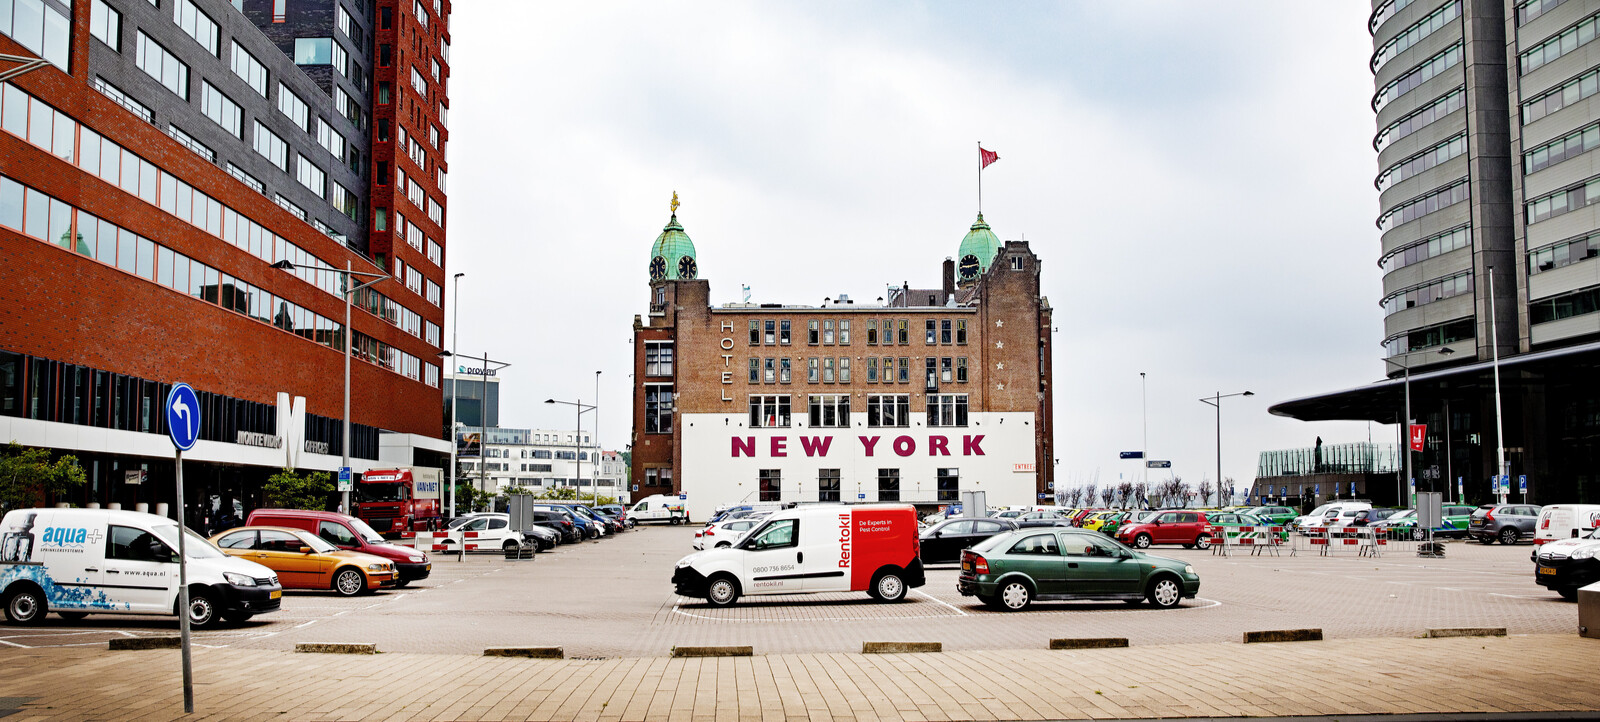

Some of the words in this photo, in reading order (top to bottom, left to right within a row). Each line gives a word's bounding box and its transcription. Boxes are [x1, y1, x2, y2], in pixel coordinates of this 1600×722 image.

[720, 320, 735, 401] HOTEL
[467, 367, 497, 376] provmi
[731, 435, 833, 458] NEW
[858, 434, 986, 458] YORK
[867, 519, 886, 527] Experts
[838, 513, 850, 568] Rentokil
[124, 569, 166, 577] www.aqua.nl
[768, 565, 779, 573] 736
[780, 564, 795, 572] 8654
[753, 580, 784, 588] rentokil.nl
